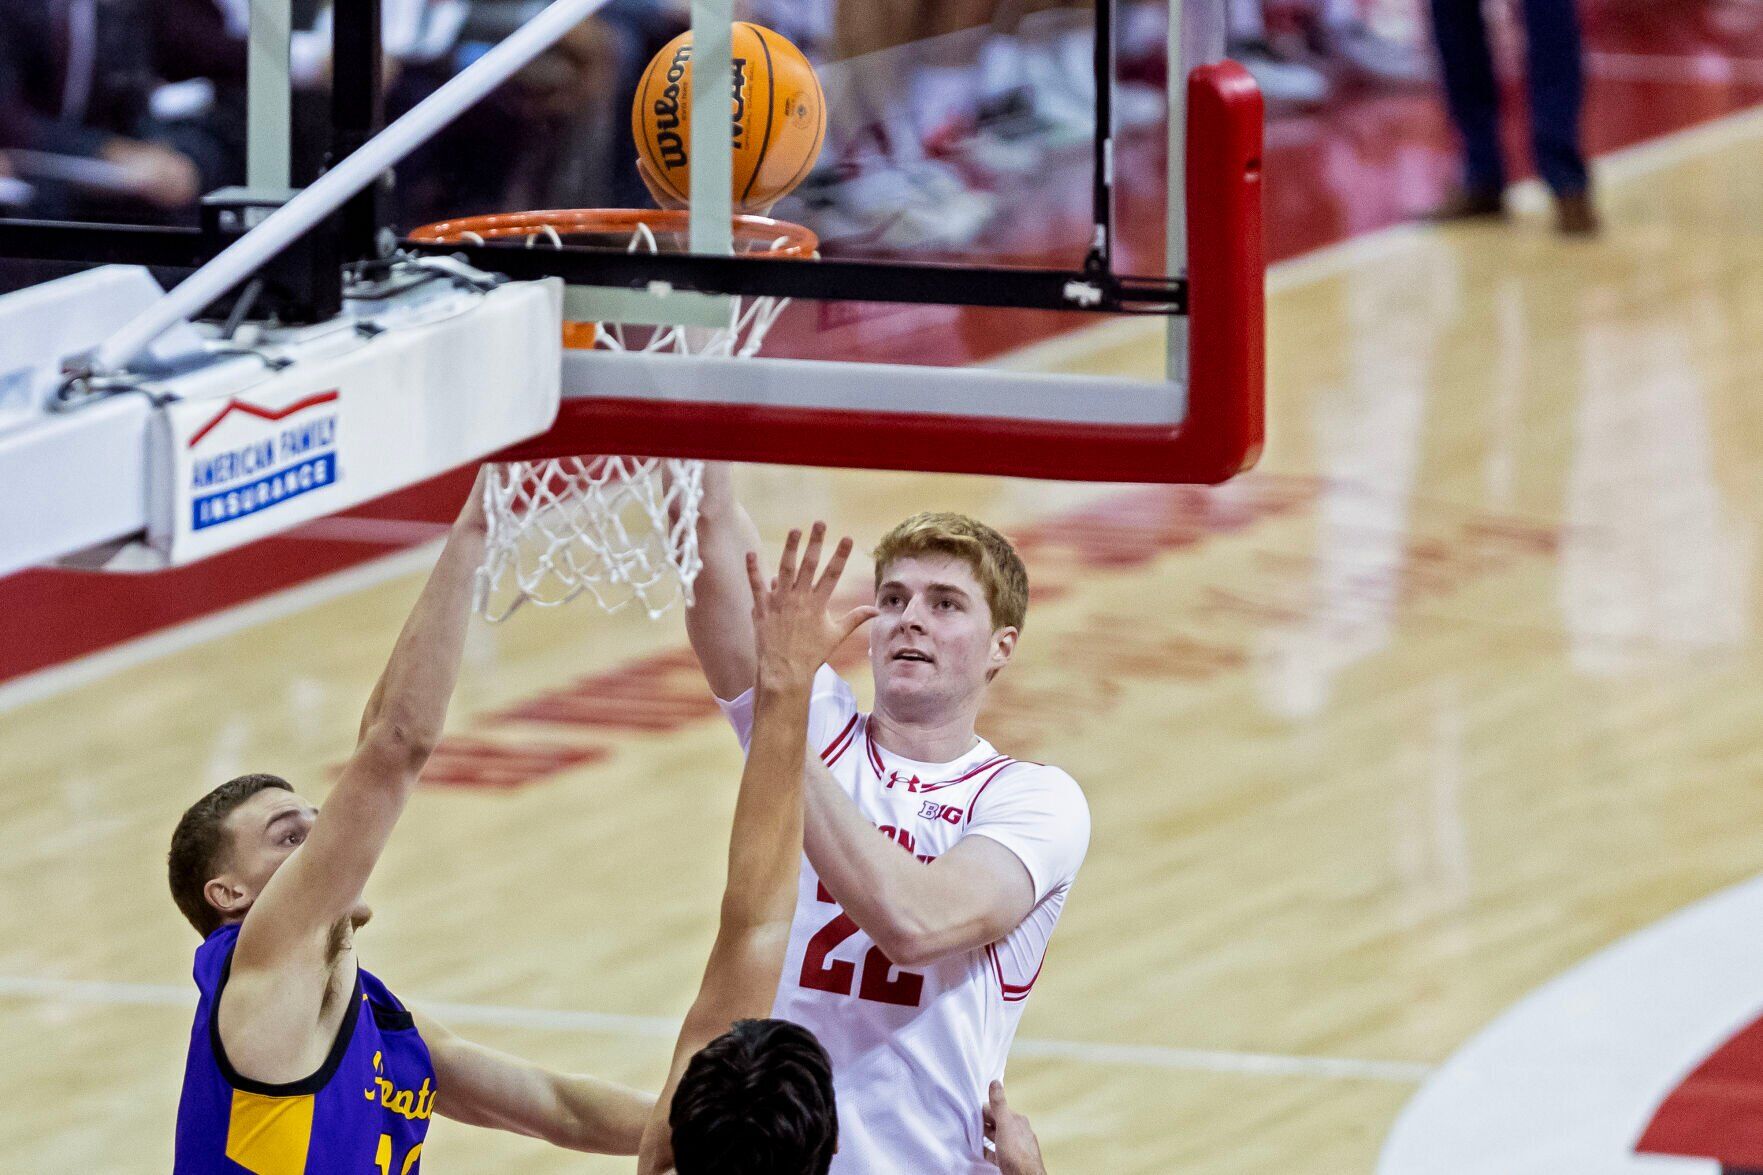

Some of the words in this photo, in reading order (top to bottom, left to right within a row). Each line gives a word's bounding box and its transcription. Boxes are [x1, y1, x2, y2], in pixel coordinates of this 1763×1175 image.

[654, 46, 692, 170] Wilson
[193, 436, 276, 490] AMERICAN
[281, 415, 336, 460] FAMILY
[199, 458, 328, 522] INSURANCE
